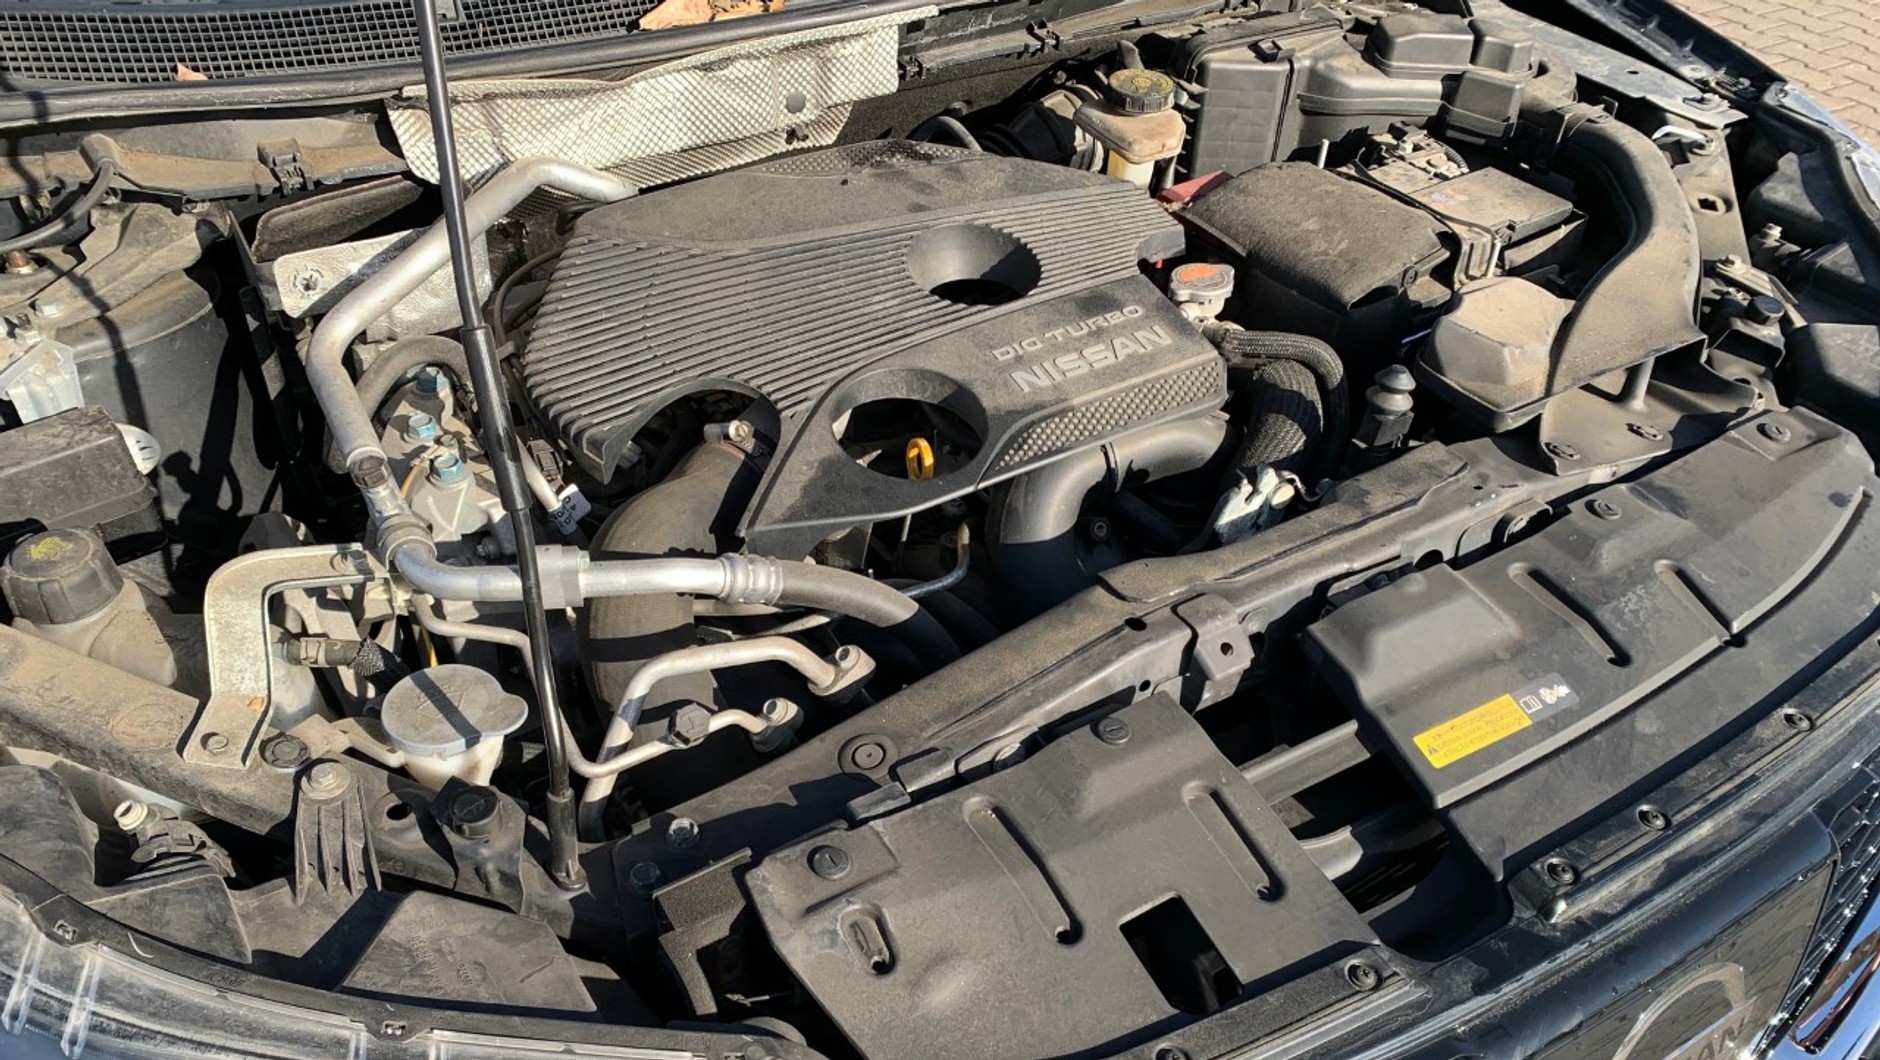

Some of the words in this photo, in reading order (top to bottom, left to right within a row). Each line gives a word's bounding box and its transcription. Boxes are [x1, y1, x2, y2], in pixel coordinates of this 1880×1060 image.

[991, 336, 1043, 361] DIG
[1043, 305, 1143, 342] TURBO
[1009, 325, 1173, 392] NISSAN
